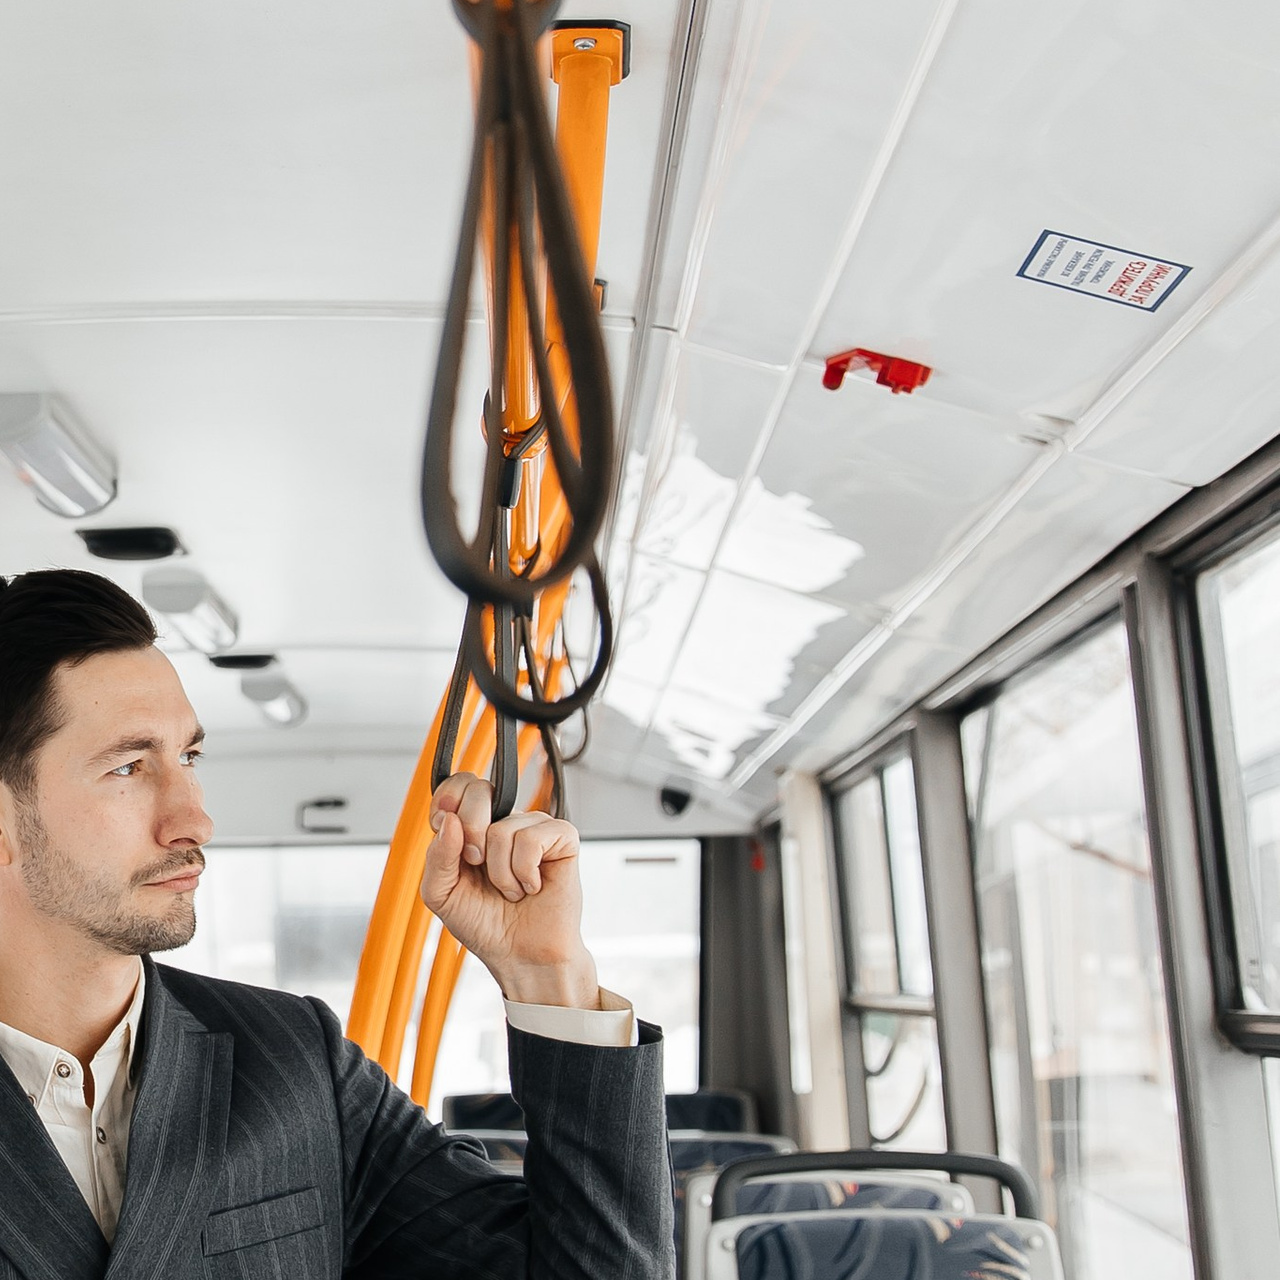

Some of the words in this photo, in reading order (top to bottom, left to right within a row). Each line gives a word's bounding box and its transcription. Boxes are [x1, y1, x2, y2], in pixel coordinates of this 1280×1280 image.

[1107, 261, 1147, 297] ДЕРЖИТЕСЬ
[1135, 264, 1172, 297] ПОРУЧНИ!
[1128, 294, 1147, 304] ЗА
